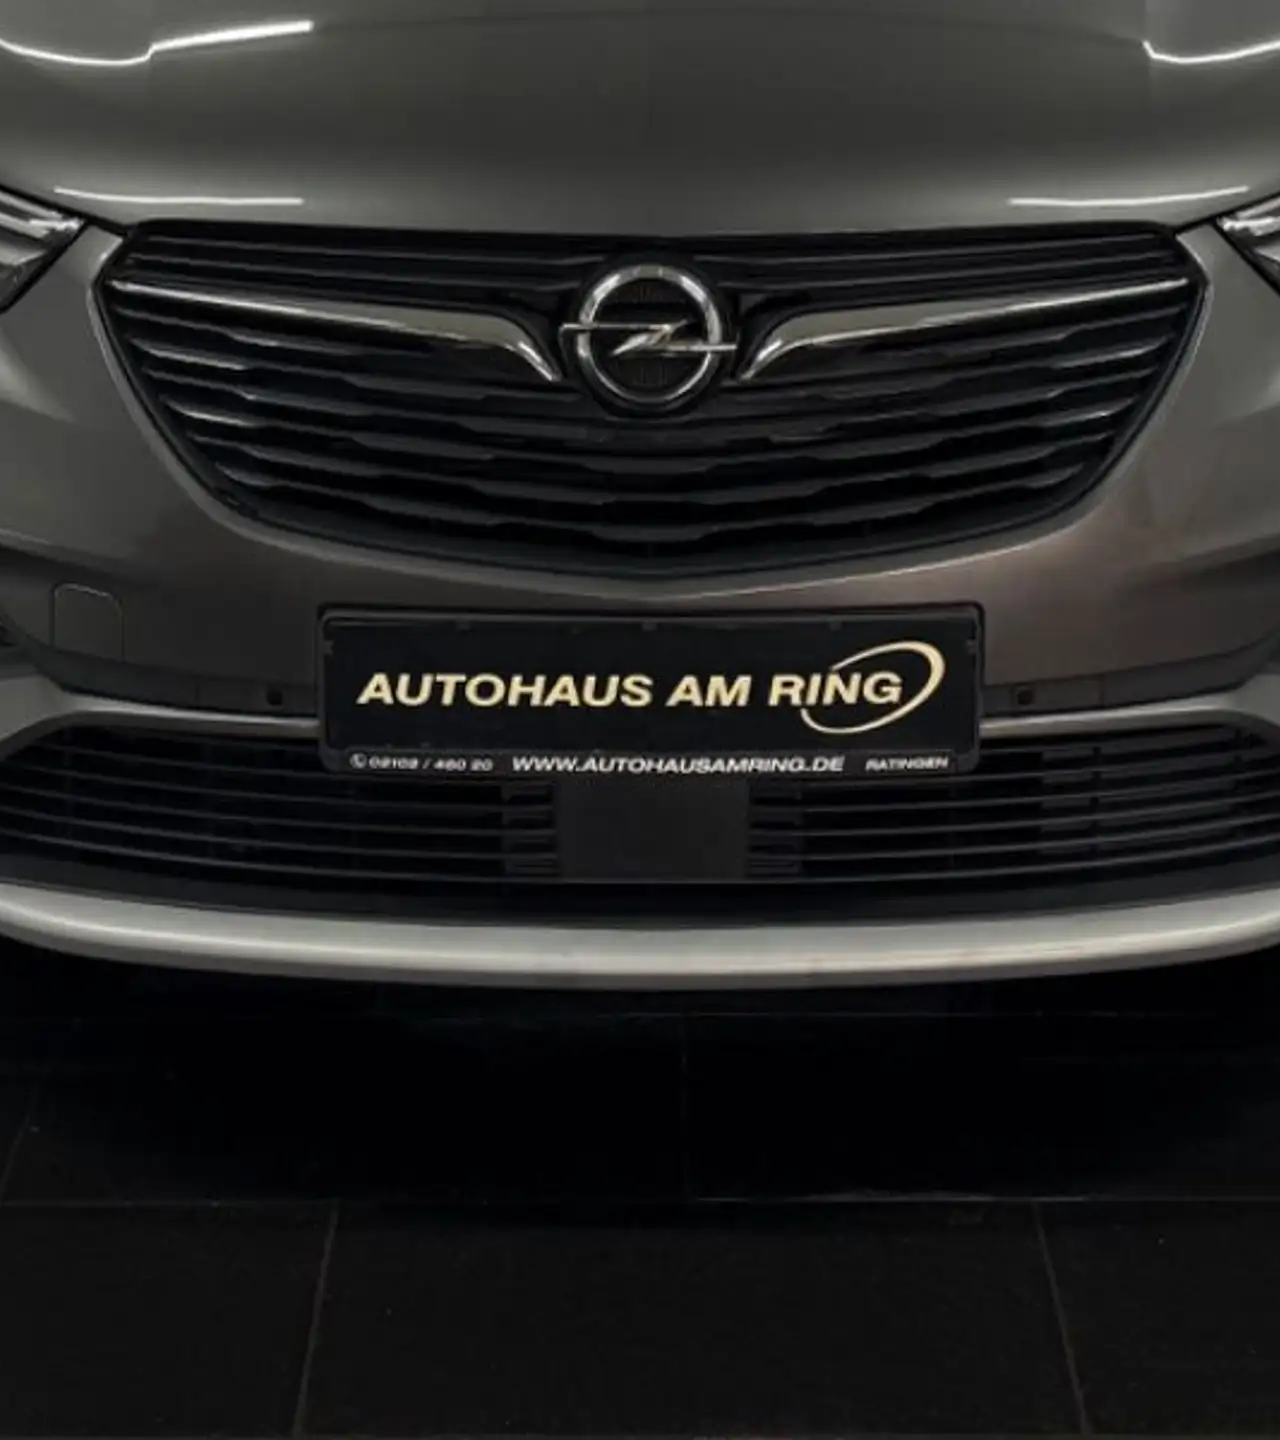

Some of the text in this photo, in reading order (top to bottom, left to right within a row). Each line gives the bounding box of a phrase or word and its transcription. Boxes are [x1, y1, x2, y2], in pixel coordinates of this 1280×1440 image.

[356, 670, 903, 707] AUTOHAUS AM RING
[512, 755, 846, 774] WWW.AUTOHAUSAMRING.DE
[865, 756, 949, 772] RATINGEN
